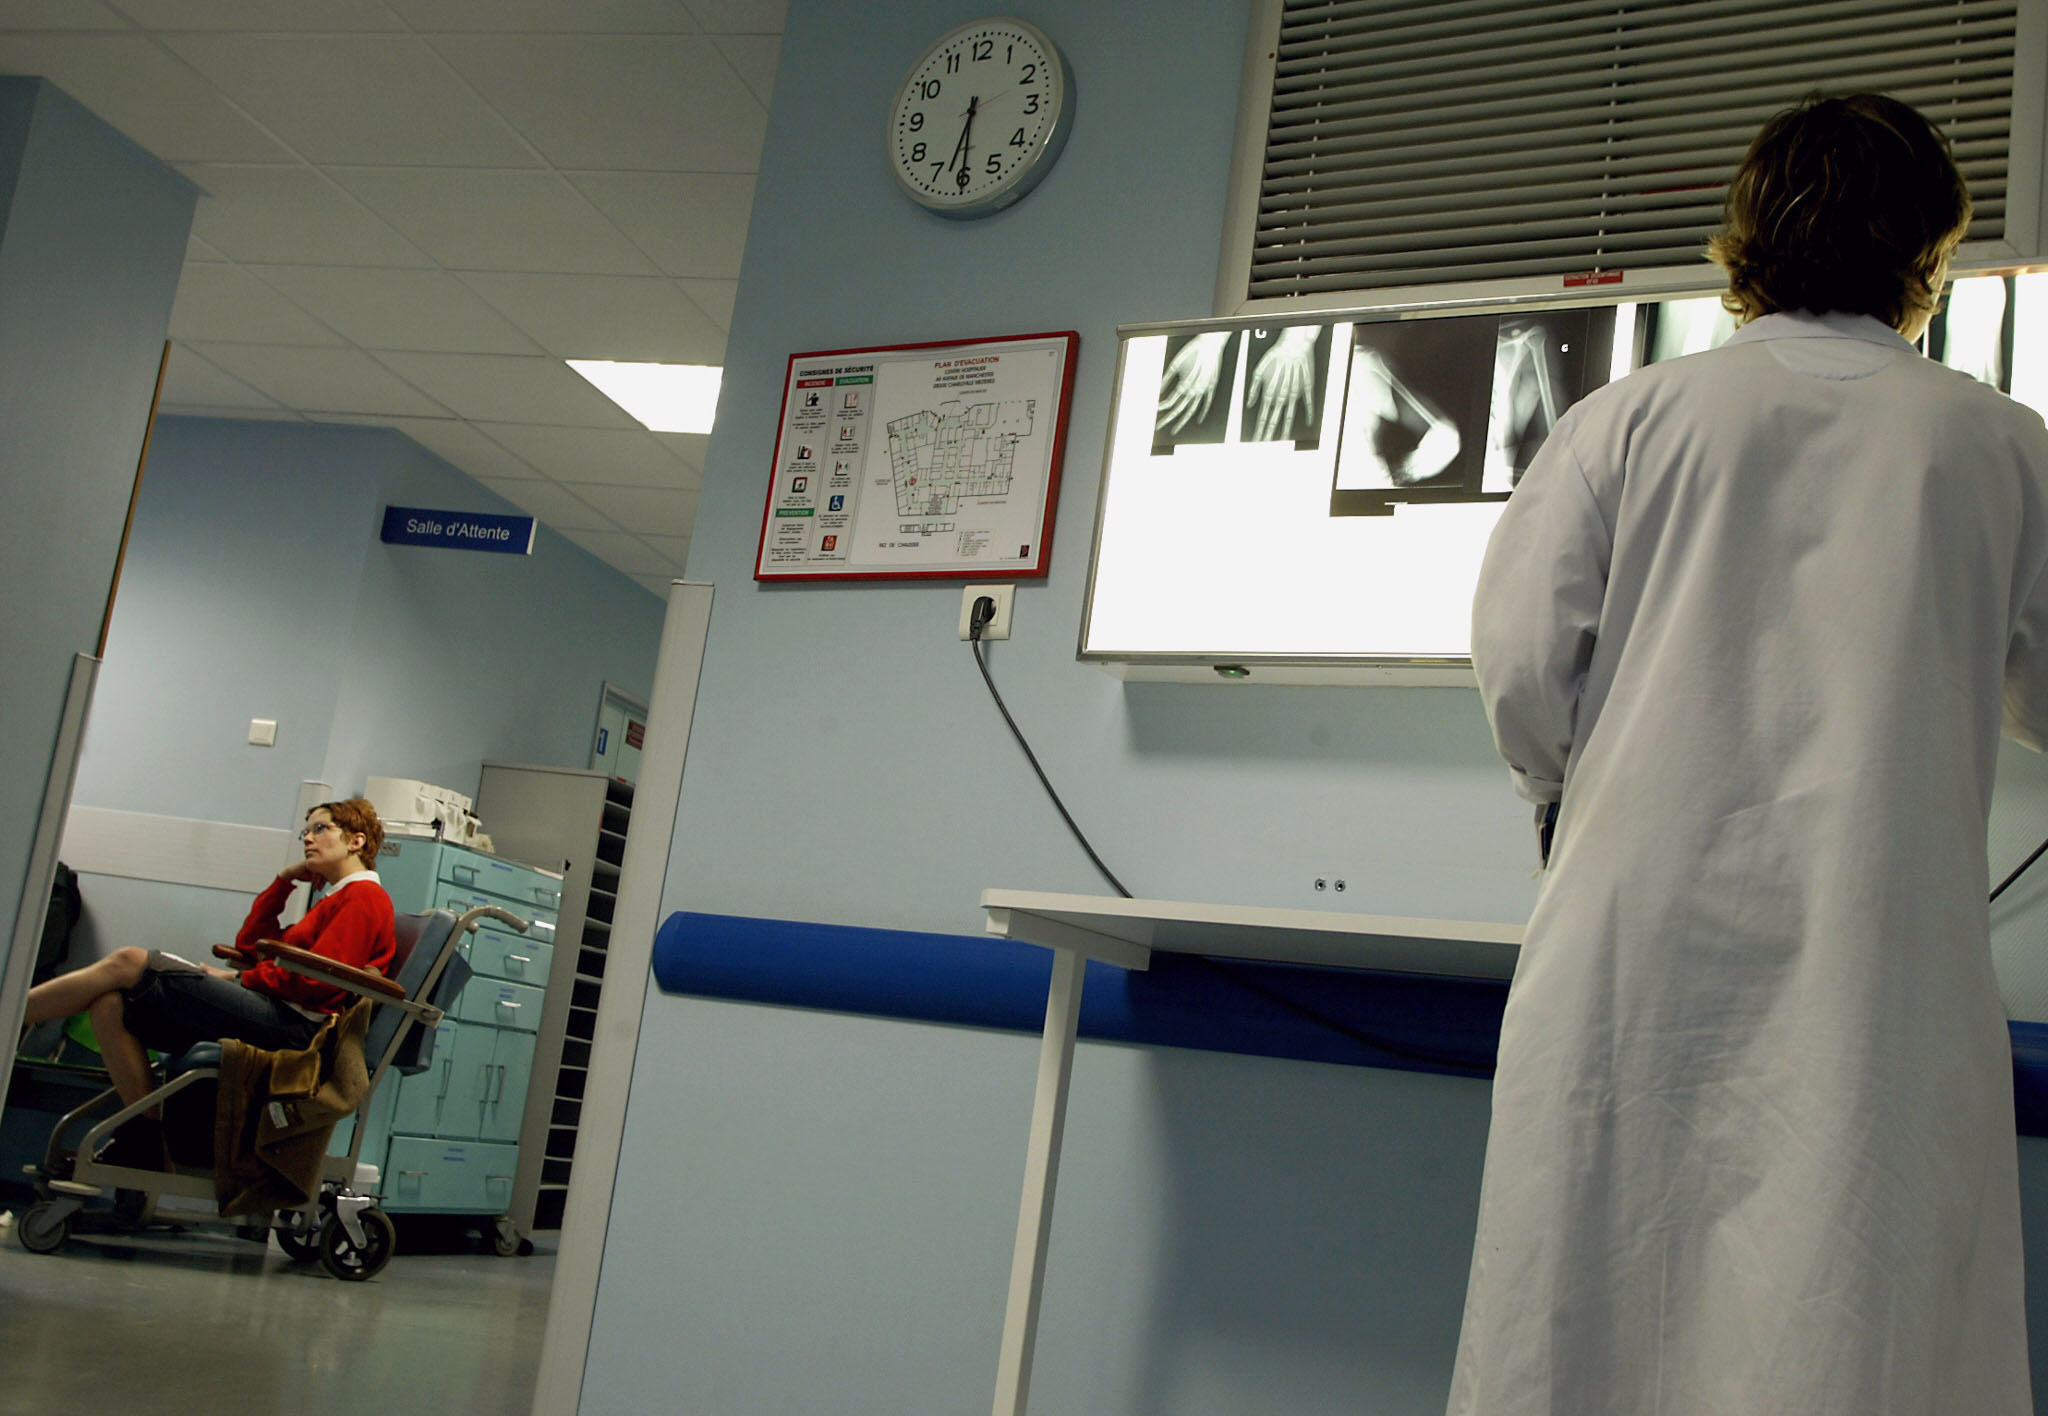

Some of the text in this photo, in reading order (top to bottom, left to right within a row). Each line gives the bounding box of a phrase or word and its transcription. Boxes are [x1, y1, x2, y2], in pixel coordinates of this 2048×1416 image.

[972, 40, 993, 62] 12
[1006, 44, 1013, 64] 1
[947, 53, 960, 74] 11
[1019, 64, 1036, 85] 2
[920, 79, 941, 100] 10
[1023, 94, 1039, 115] 3
[909, 112, 924, 132] 9
[1009, 127, 1025, 148] 4
[911, 142, 927, 162] 8
[930, 161, 944, 183] 7
[985, 153, 1002, 174] 5
[956, 166, 970, 187] 6
[800, 368, 834, 377] CONSIGNES
[835, 367, 843, 375] DE
[935, 360, 951, 368] PLAN
[406, 518, 510, 541] Salle d'Attente
